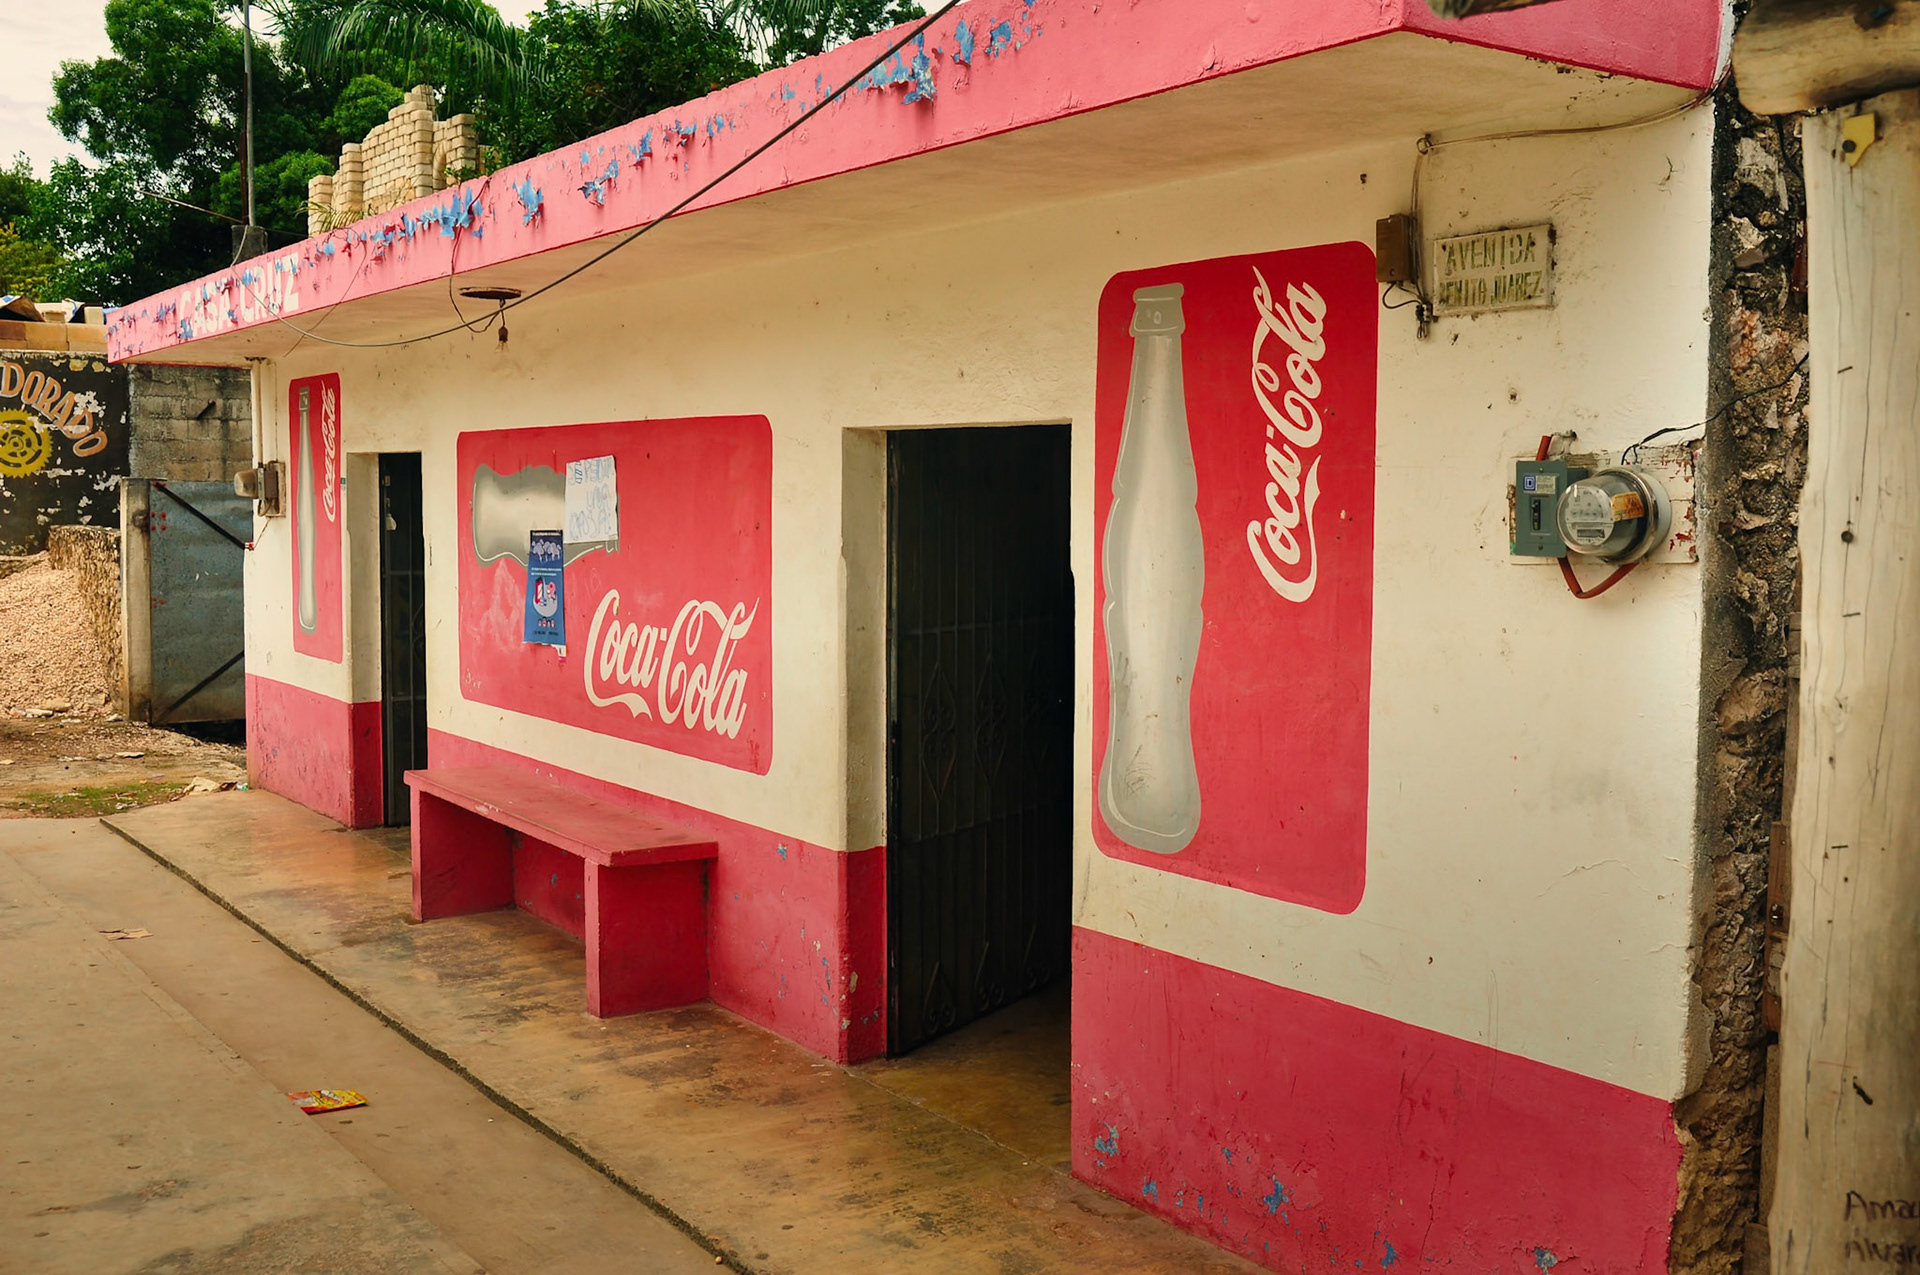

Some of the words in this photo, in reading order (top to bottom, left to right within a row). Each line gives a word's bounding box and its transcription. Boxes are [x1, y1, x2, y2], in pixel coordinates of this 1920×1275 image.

[240, 252, 299, 323] CRUZ
[1444, 232, 1536, 272] AVENIDA
[1490, 270, 1543, 305] JUAREZ
[0, 362, 108, 457] DORADO
[321, 379, 336, 523] Coca-Cola
[1247, 265, 1327, 603] Coca-Cola
[583, 589, 760, 740] Coca-Cola
